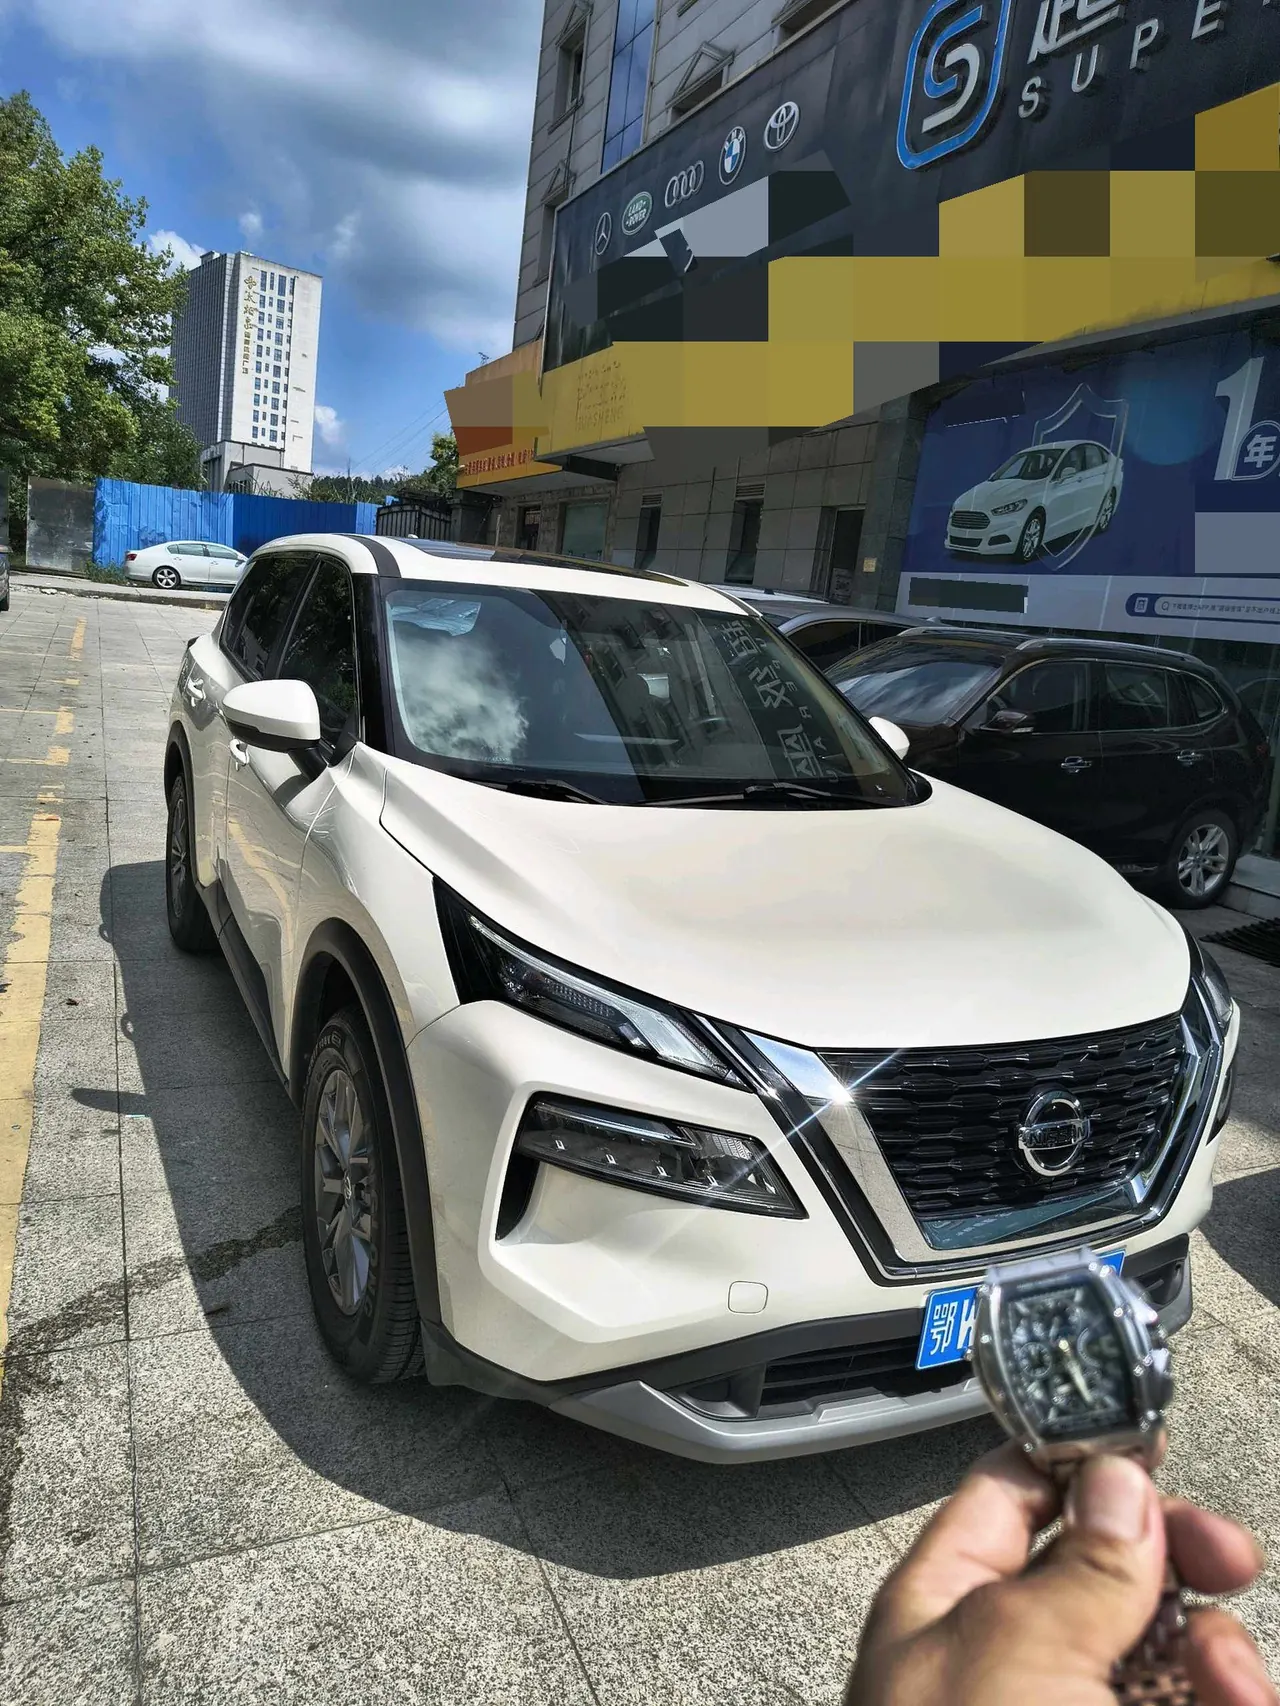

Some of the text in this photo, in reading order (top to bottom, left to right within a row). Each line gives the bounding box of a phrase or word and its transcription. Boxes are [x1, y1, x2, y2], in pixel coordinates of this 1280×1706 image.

[1018, 0, 1272, 119] SUPE
[627, 208, 647, 227] ROVER
[628, 200, 644, 217] LAND
[1214, 356, 1277, 480] 1 年
[1027, 1124, 1087, 1146] NISSAN
